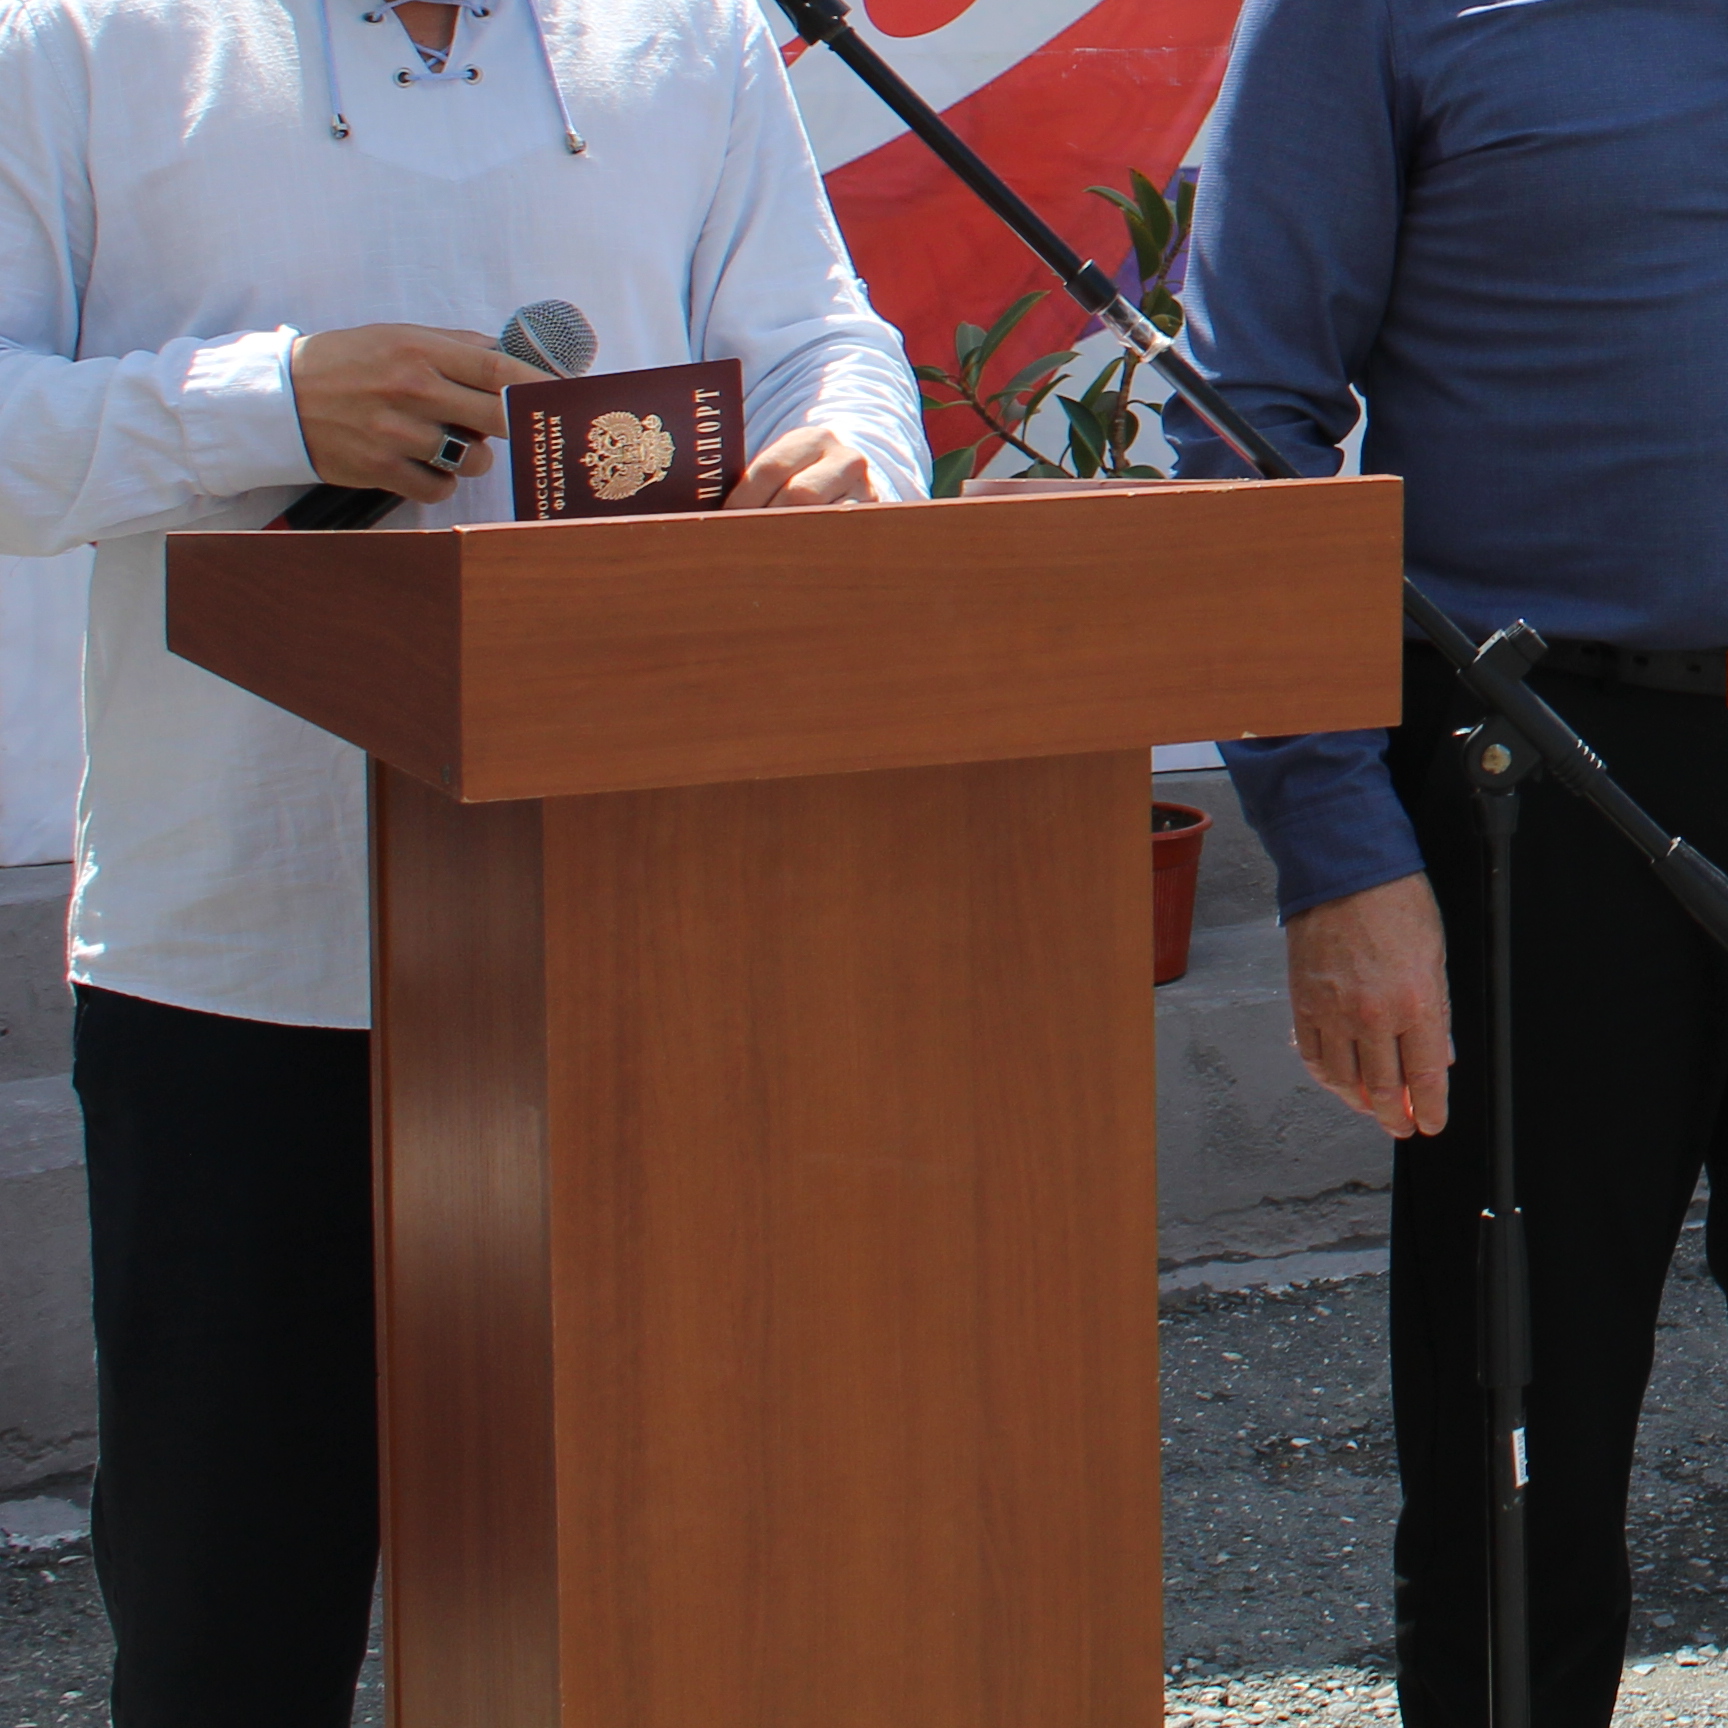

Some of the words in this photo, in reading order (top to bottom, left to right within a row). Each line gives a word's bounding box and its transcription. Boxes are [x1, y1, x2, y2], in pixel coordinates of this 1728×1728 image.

[533, 411, 550, 520] РОССИЙСКАЯ
[549, 415, 566, 511] ФЕДЕРАЦИЯ
[695, 388, 722, 500] ПАСПОРТ
